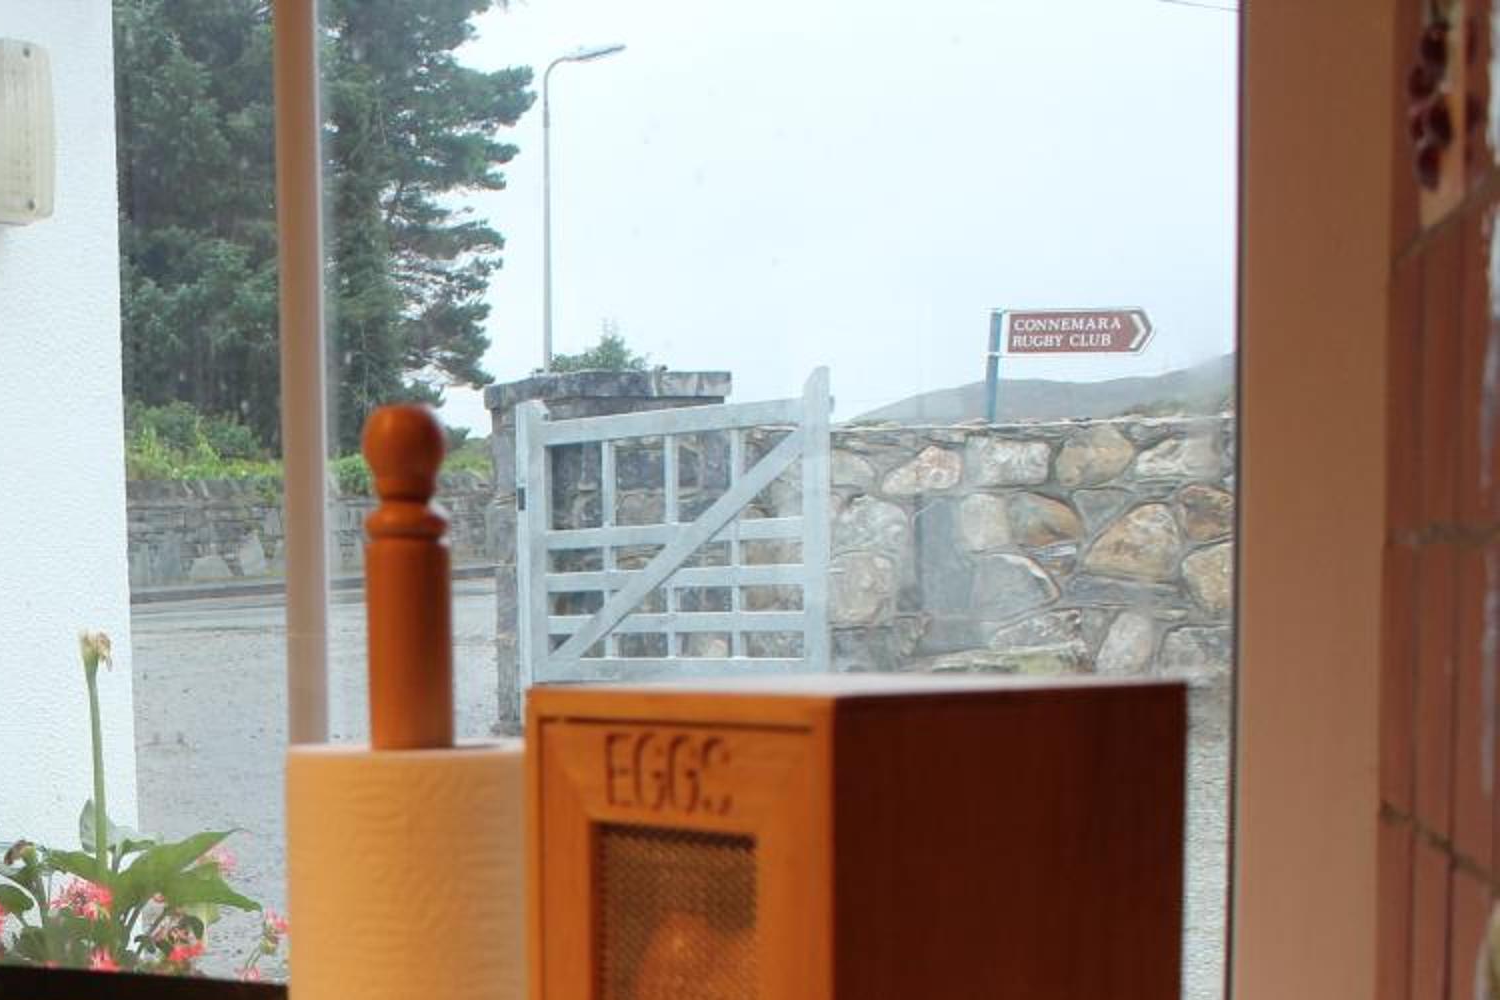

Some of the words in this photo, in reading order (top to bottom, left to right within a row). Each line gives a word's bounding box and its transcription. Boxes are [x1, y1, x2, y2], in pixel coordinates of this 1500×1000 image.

[1013, 316, 1122, 331] CONNEMARA
[1012, 334, 1063, 348] RUGBY
[1069, 333, 1112, 347] CLUB
[605, 733, 734, 817] EGGS
